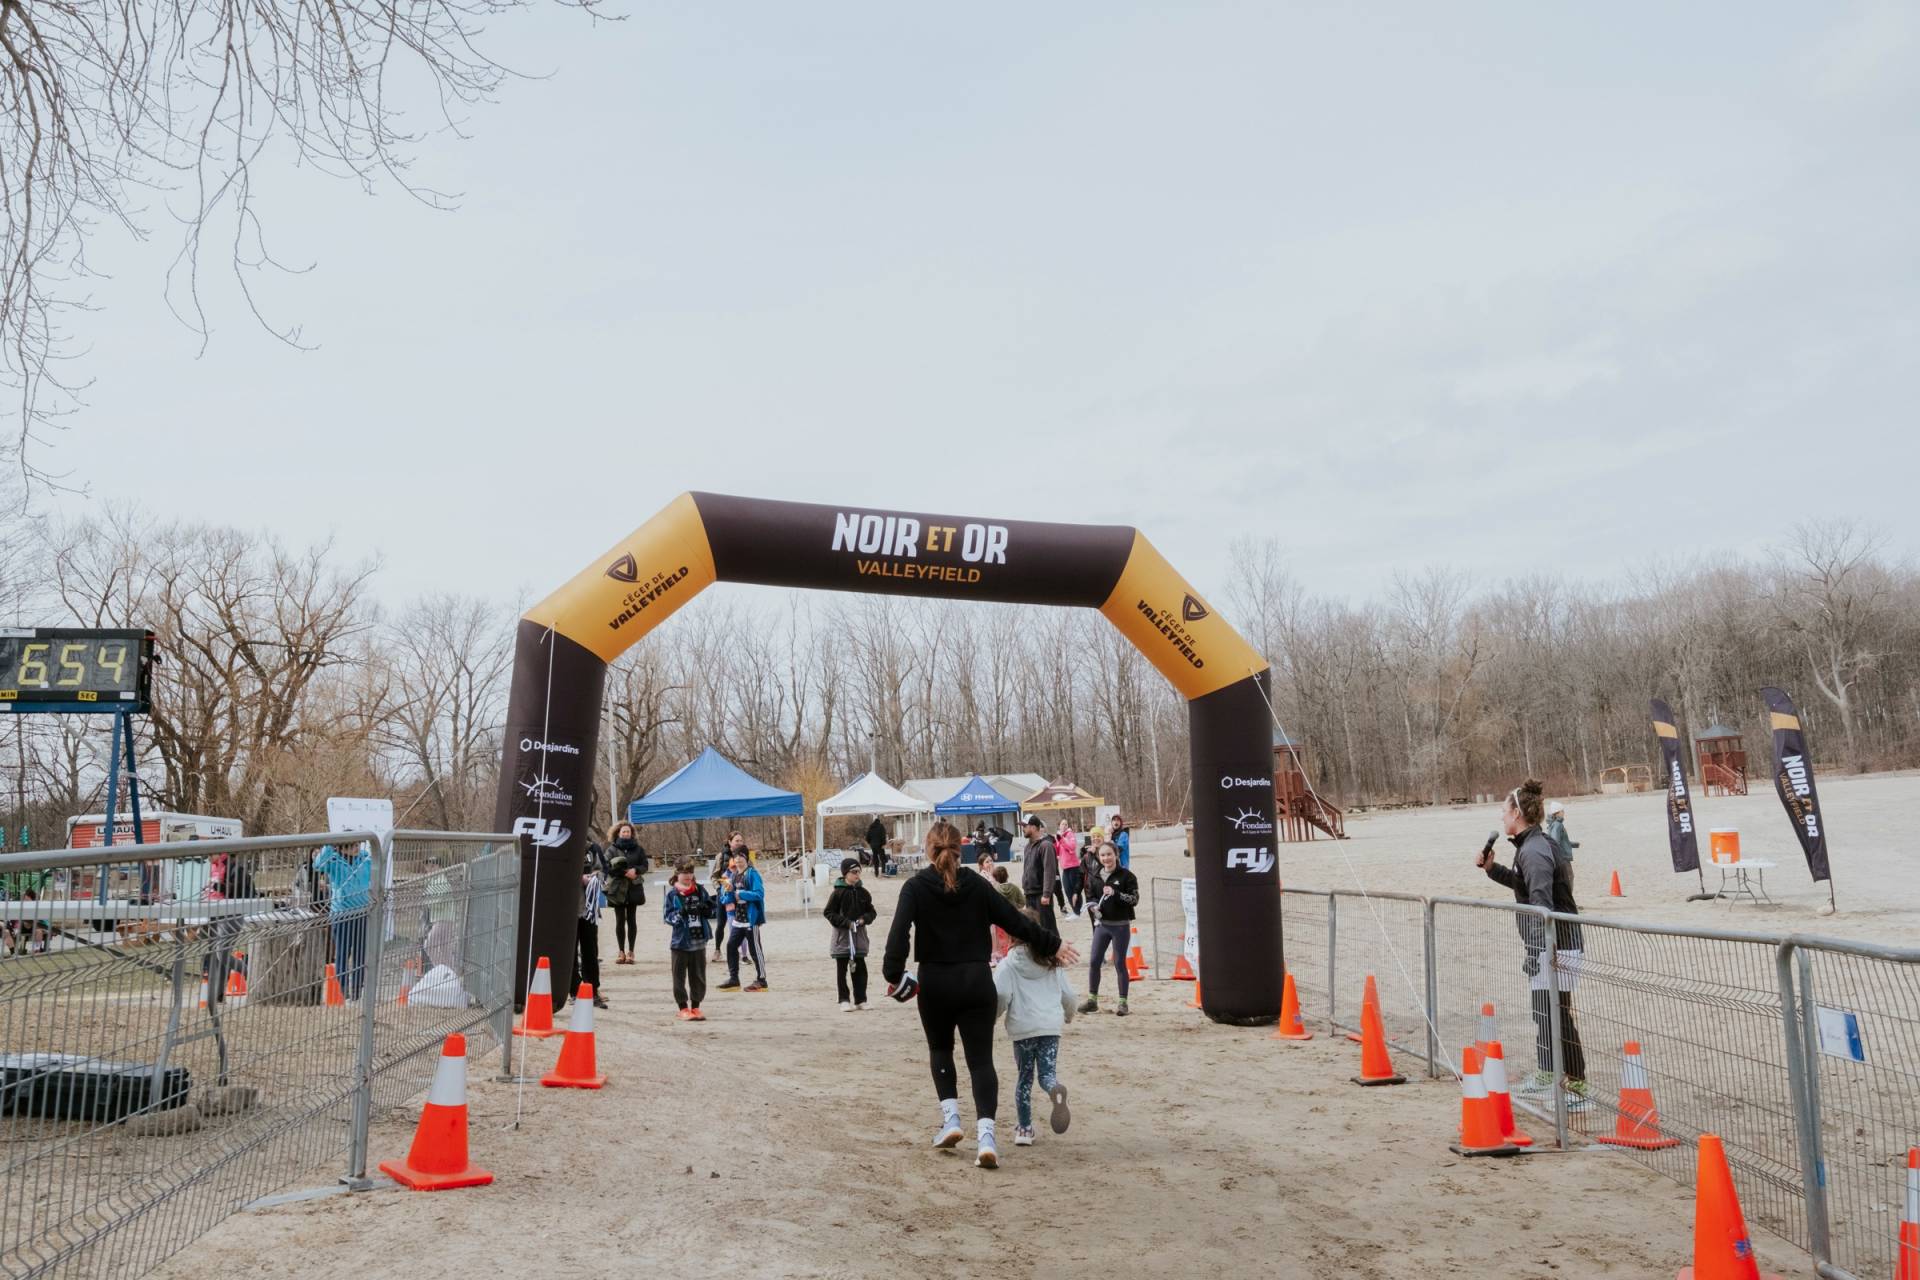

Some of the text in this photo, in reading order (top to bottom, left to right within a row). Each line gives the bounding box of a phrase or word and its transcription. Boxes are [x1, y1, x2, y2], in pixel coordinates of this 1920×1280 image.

[832, 512, 1009, 564] NOIR ET OR
[857, 559, 981, 583] VALLEYFIELD
[608, 566, 689, 630] VALLEYFIELD
[622, 571, 666, 607] CÉGEP DE
[1137, 599, 1204, 669] VALLEYFIELD
[1160, 609, 1197, 647] CÉGEP DE
[79, 692, 97, 700] SEC
[533, 741, 580, 755] Desjardins
[534, 789, 573, 801] Fondation
[1235, 778, 1271, 787] Desjardins
[1782, 754, 1810, 797] NOIR
[1805, 814, 1819, 837] OR
[1779, 772, 1806, 825] VALLEYFIELD
[1241, 821, 1272, 830] Fondation
[1679, 812, 1692, 833] OR
